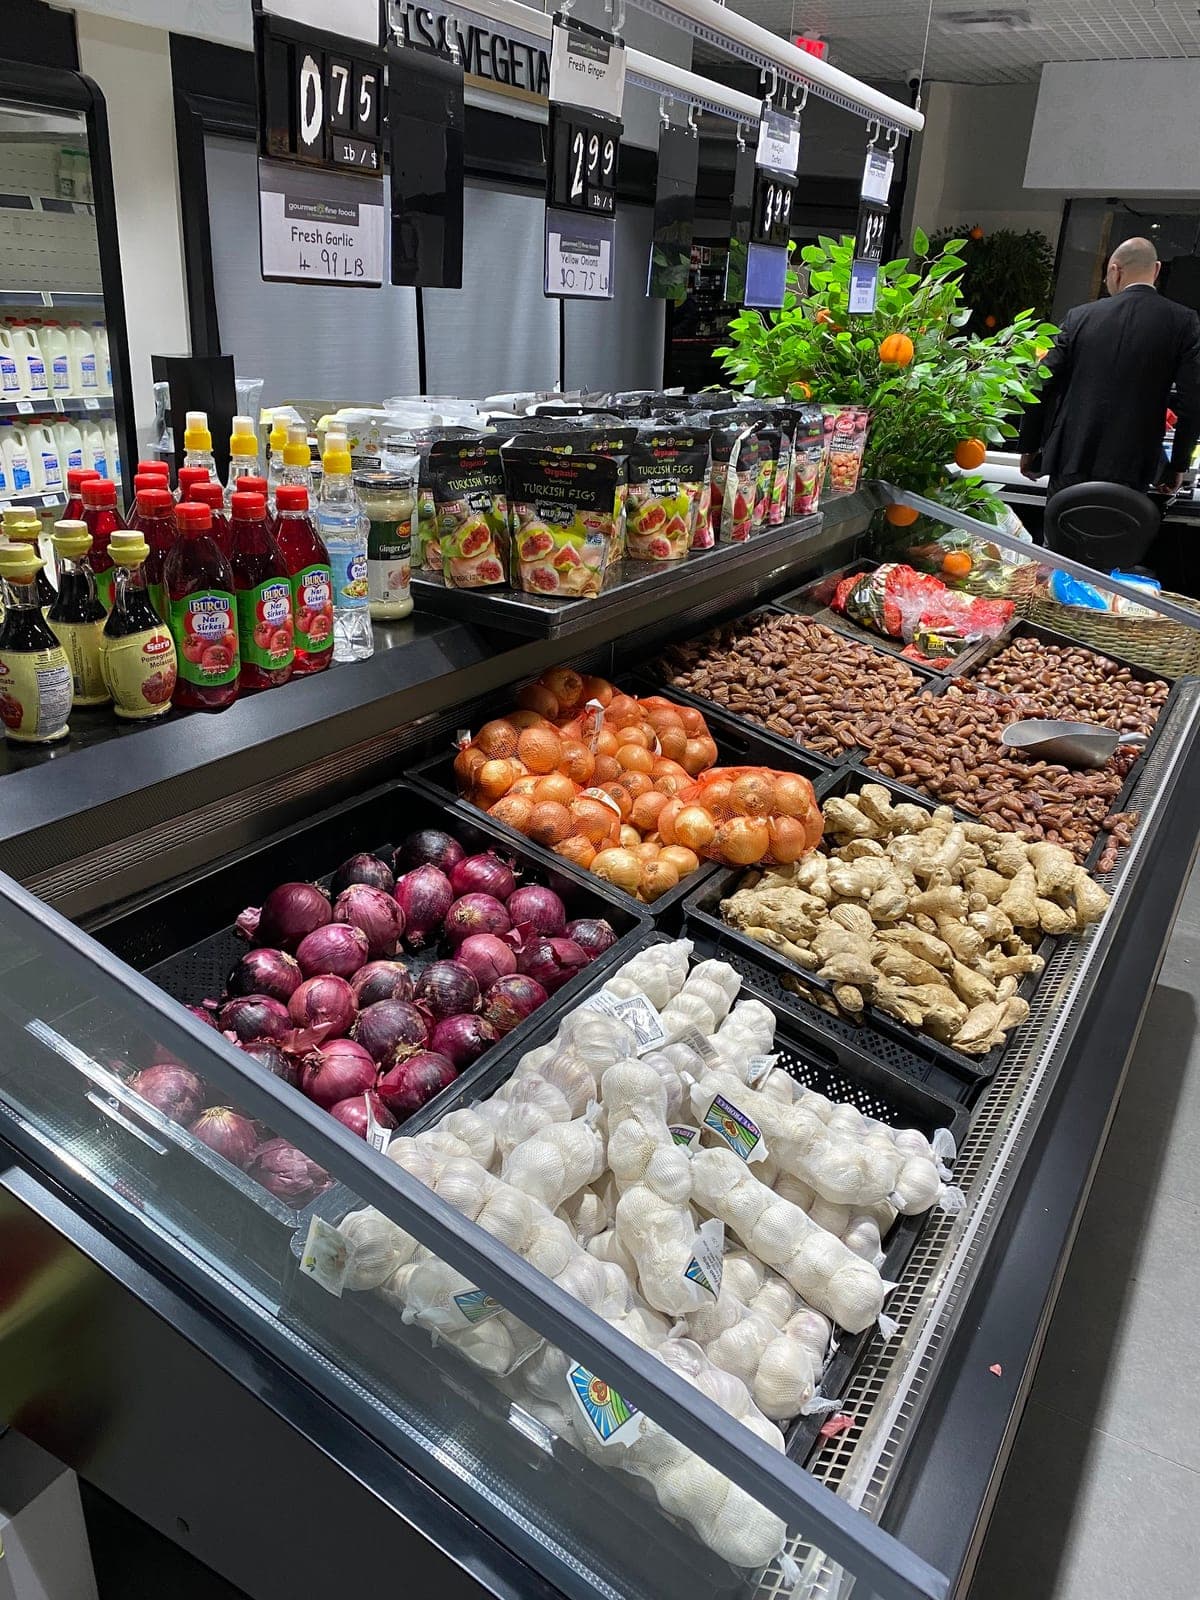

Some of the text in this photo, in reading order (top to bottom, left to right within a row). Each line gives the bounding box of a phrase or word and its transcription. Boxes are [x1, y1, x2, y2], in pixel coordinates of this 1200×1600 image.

[568, 57, 586, 72] Fresh
[288, 202, 317, 212] gourmet
[325, 206, 337, 214] fine
[338, 208, 356, 217] foods
[291, 226, 354, 247] Fresh Garlic
[561, 253, 579, 265] Yellow
[344, 257, 364, 277] LB
[543, 467, 578, 478] Organic
[638, 465, 694, 475] TURKISH FIGS
[447, 474, 503, 491] TURKISH FIGS
[523, 483, 596, 502] TURKISH FIGS
[379, 545, 401, 553] Ginger
[192, 601, 227, 612] BURCU
[270, 602, 282, 610] Nar
[196, 622, 226, 631] Sirkesi
